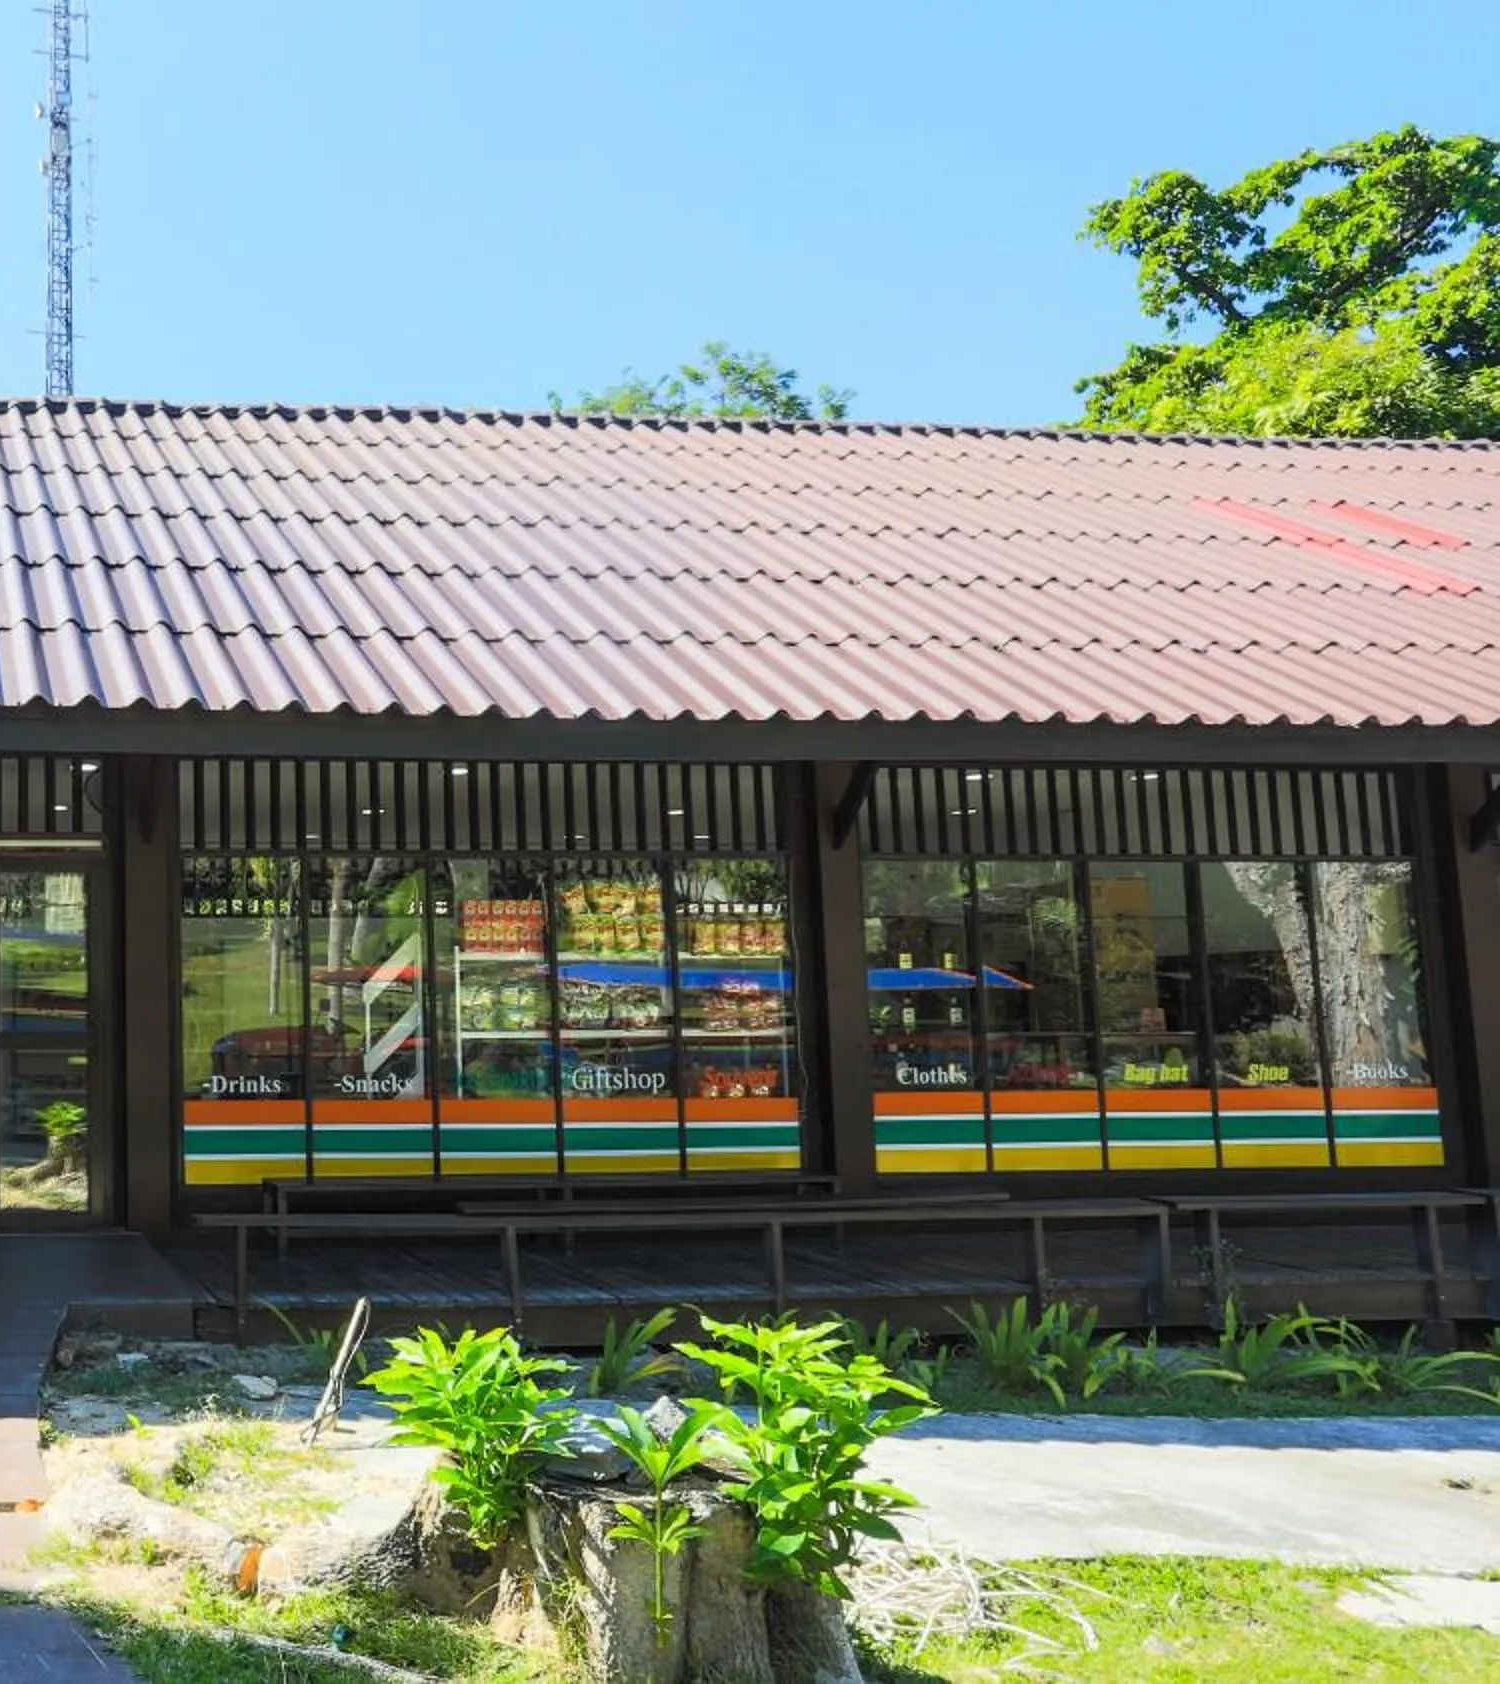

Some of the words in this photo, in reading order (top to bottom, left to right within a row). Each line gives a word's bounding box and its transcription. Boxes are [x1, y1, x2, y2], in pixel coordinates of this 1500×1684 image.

[572, 1067, 665, 1094] Giftshop
[899, 1066, 968, 1085] Clothes
[1123, 1063, 1156, 1083] Bag
[1159, 1063, 1189, 1081] hat
[1249, 1063, 1289, 1081] Shoe
